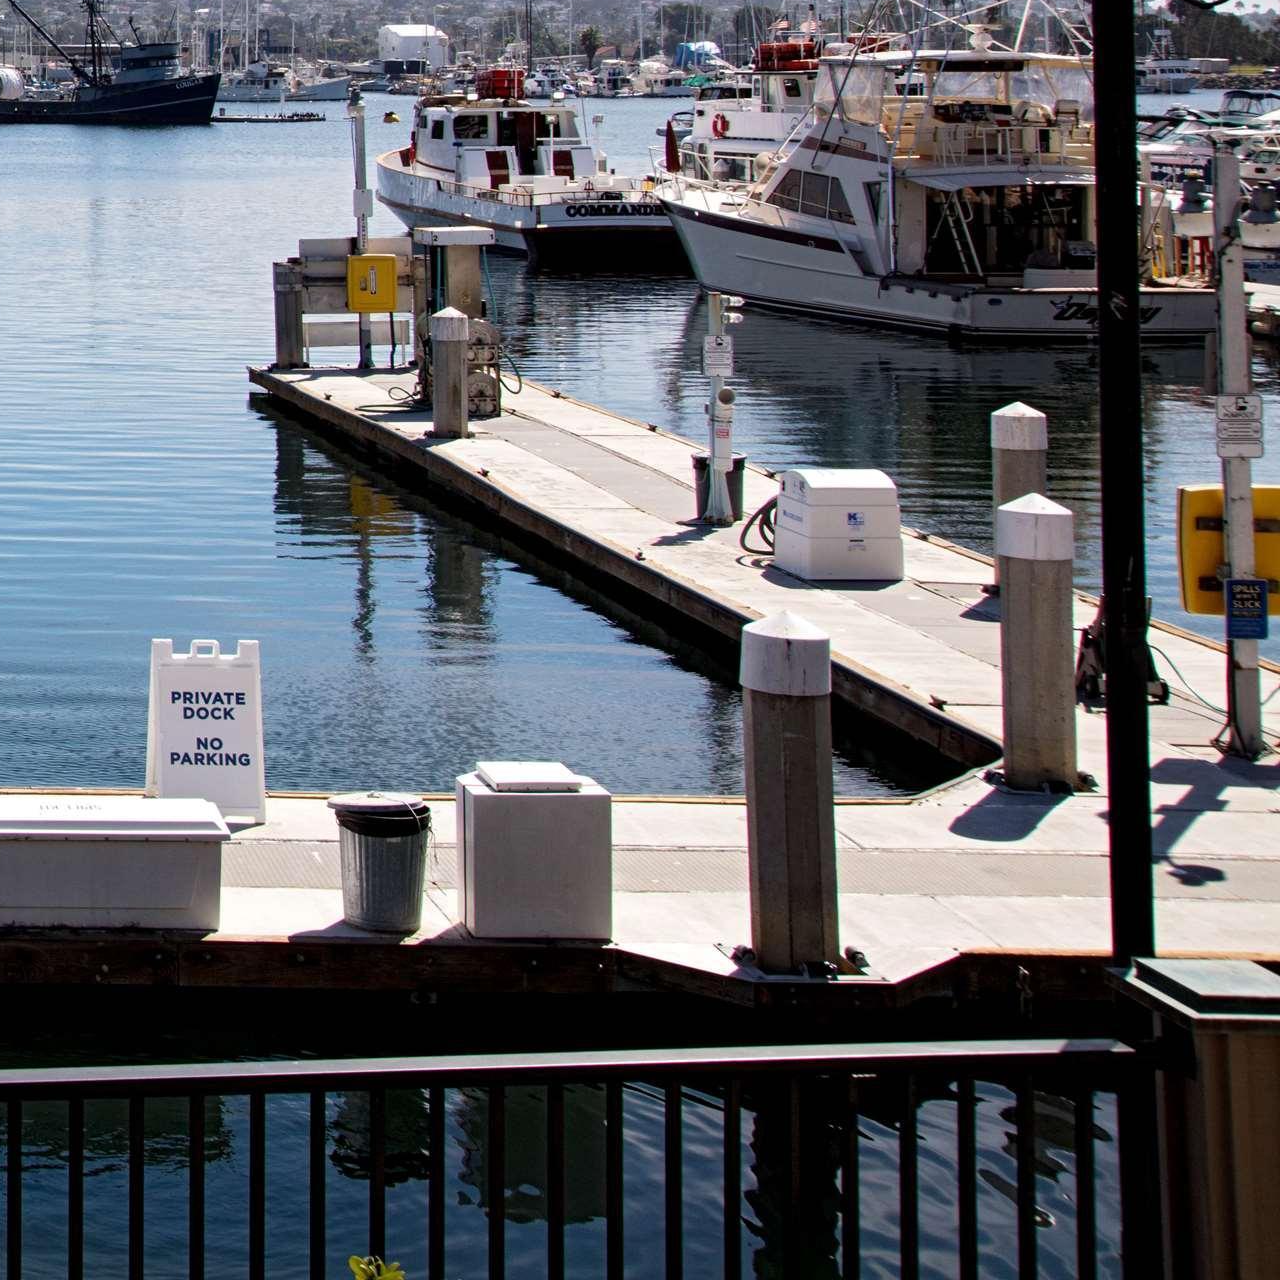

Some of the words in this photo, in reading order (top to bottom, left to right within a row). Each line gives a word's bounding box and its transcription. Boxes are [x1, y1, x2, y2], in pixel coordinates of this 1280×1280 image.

[565, 204, 665, 217] COMMANDE
[1232, 584, 1261, 592] SPILLS
[171, 691, 246, 705] PRIVATE
[183, 706, 235, 720] DOCK
[196, 737, 223, 750] NO
[170, 752, 251, 766] PARKING
